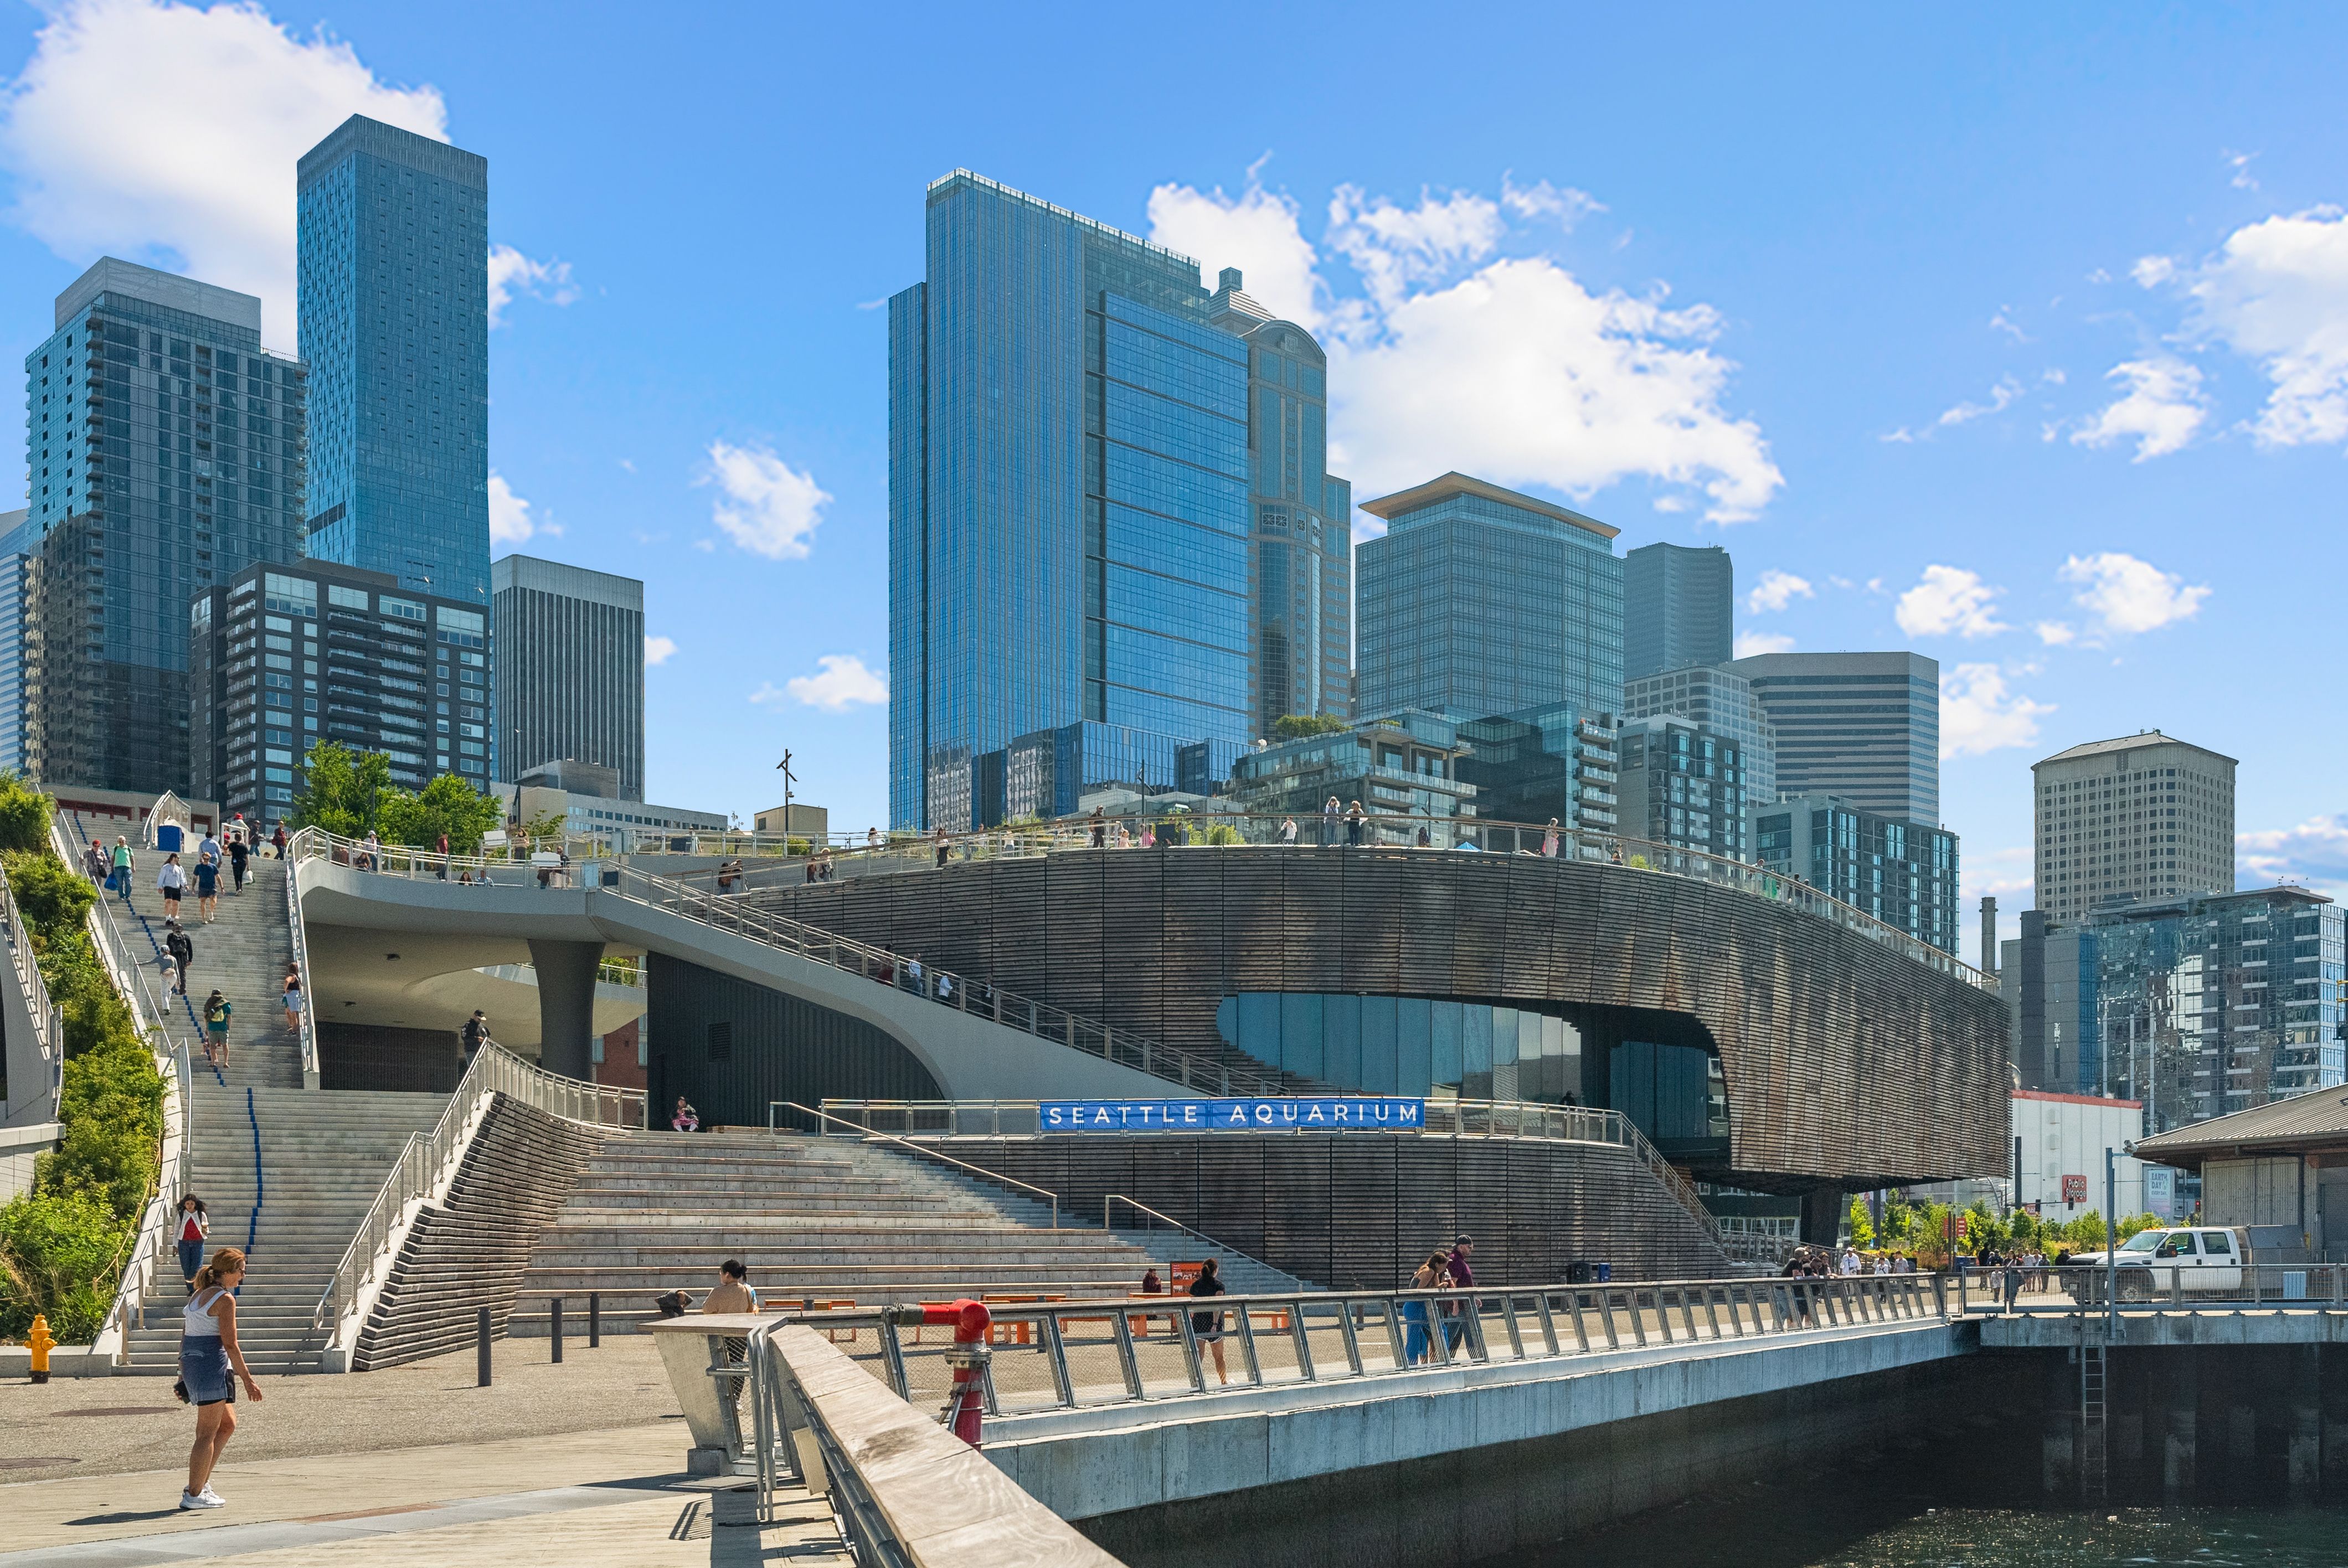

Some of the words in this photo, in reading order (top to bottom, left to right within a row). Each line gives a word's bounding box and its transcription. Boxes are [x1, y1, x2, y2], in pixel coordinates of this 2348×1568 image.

[1049, 1106, 1197, 1124] SEATTLE
[1229, 1105, 1416, 1124] AQUARIUM
[2068, 1179, 2084, 1188] Public
[2066, 1188, 2086, 1200] Storage
